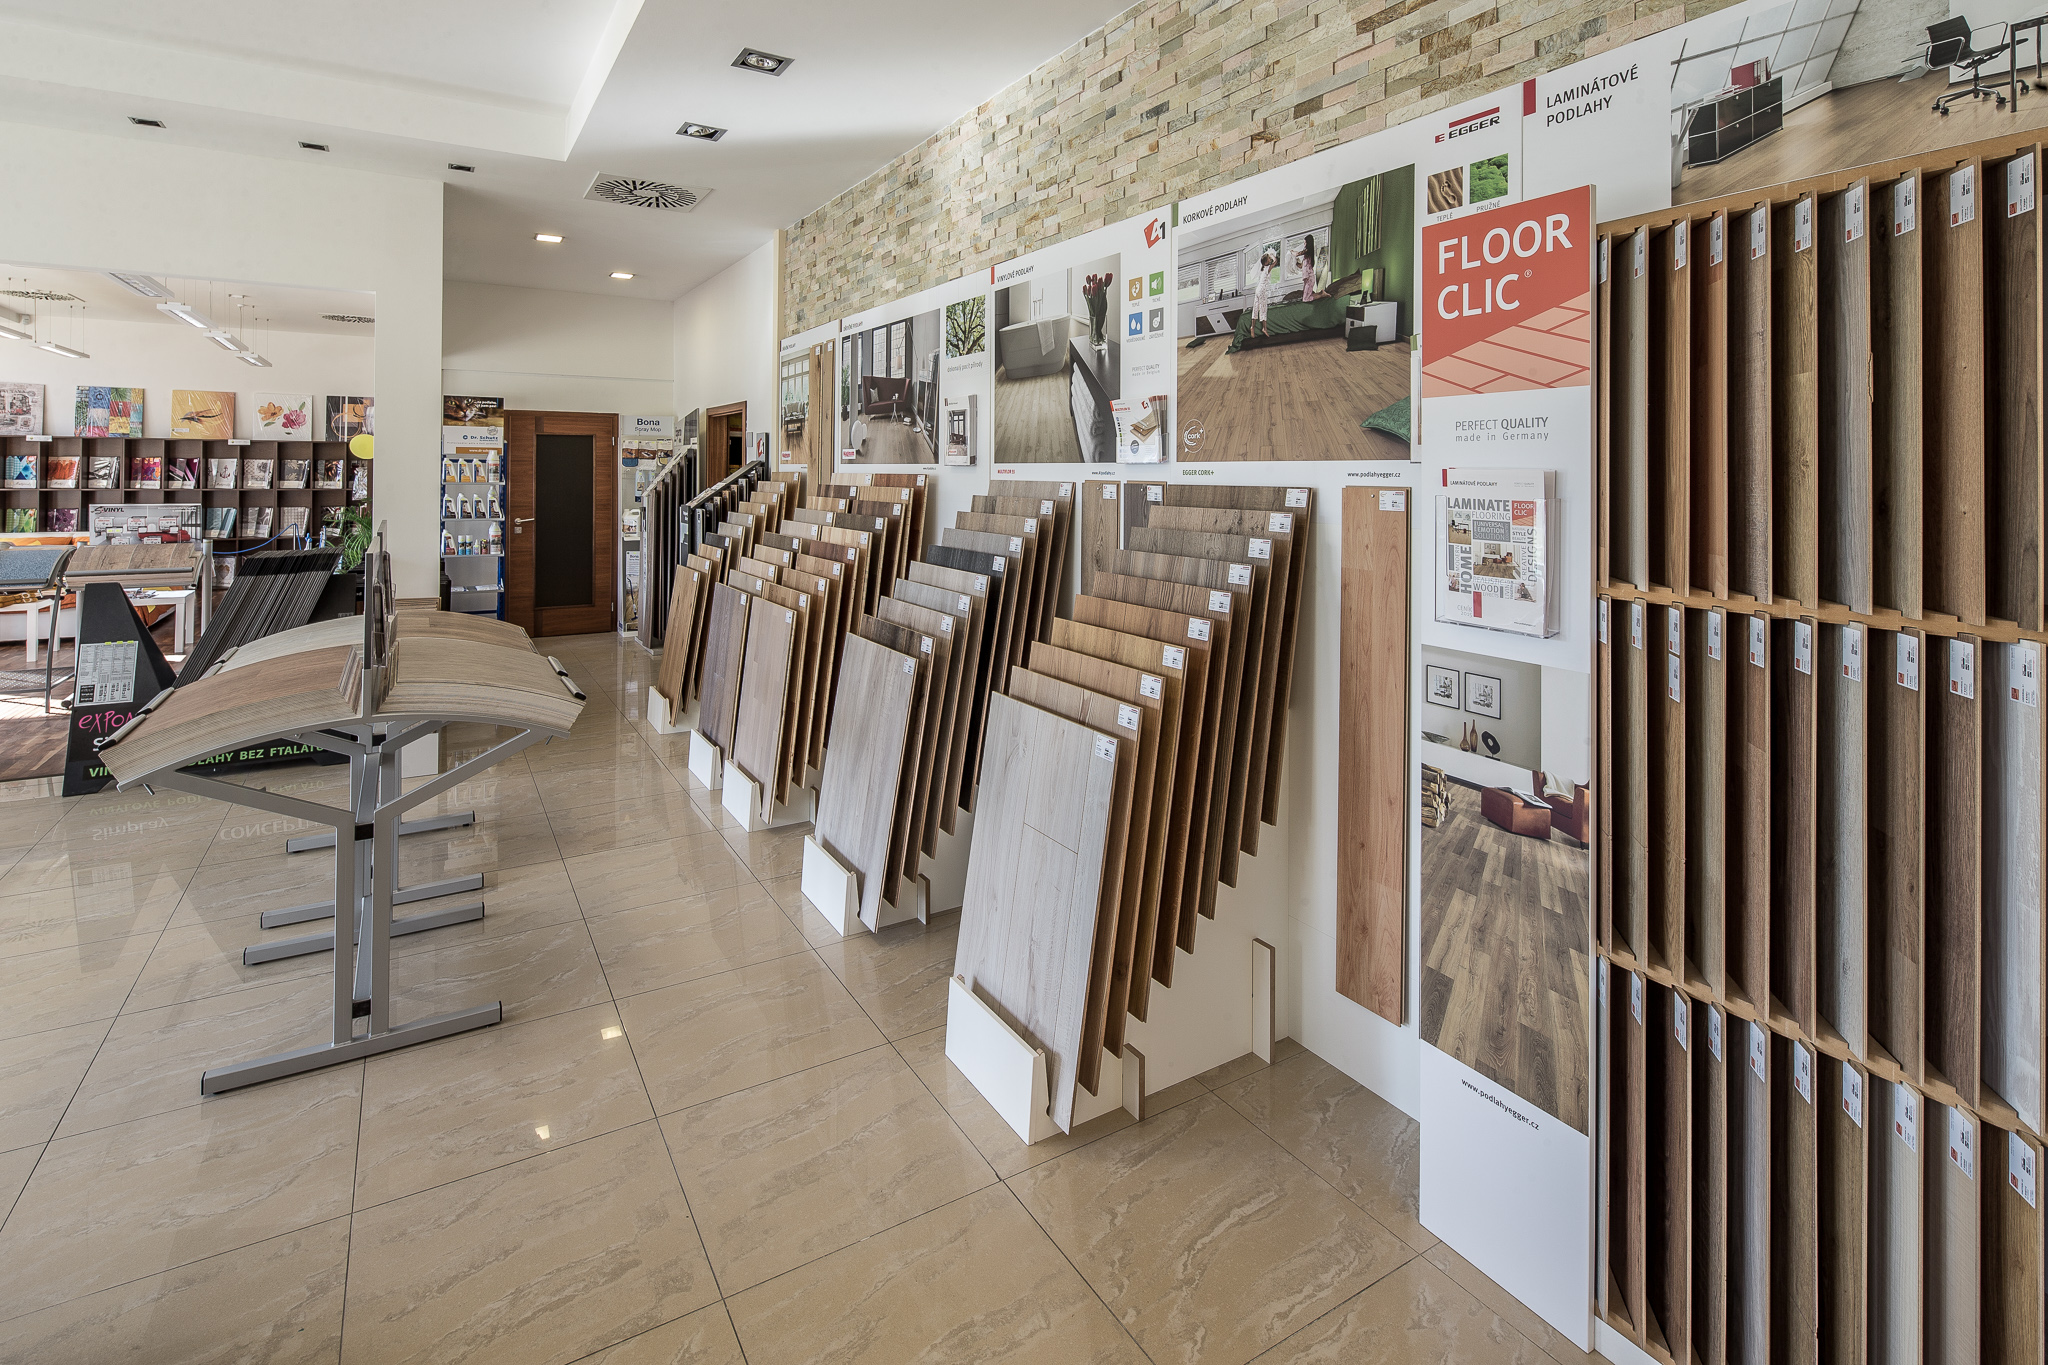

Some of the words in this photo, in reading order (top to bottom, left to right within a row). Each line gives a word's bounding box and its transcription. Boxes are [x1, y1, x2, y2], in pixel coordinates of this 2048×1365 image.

[1546, 63, 1639, 109] LAMINÁTOVÉ
[1546, 94, 1613, 128] PODLAHY
[1448, 115, 1501, 140] EGGER
[1182, 205, 1214, 225] KORKOVÉ
[1214, 195, 1248, 215] PODLAHY
[1476, 200, 1501, 213] PRUŽNÉ
[1436, 211, 1454, 222] TEPLÉ
[1438, 213, 1574, 275] FLOOR
[996, 269, 1015, 283] VINYLOVÉ
[1015, 264, 1035, 278] PODLAHY
[1437, 273, 1521, 320] CLIC
[1146, 363, 1160, 371] QUALITY
[636, 418, 660, 426] Bona
[1455, 418, 1498, 431] PERFECT
[1500, 416, 1549, 431] QUALITY
[1455, 432, 1481, 442] made
[1487, 432, 1496, 441] in
[1502, 431, 1549, 442] Germany
[1346, 471, 1401, 479] www.podlahyegger.cz
[1447, 497, 1511, 512] LAMINATE
[1471, 511, 1511, 521] FLOORING
[1526, 528, 1538, 583] DESIGNS
[1460, 546, 1473, 595] HOME
[1472, 583, 1499, 593] WOOD
[239, 748, 265, 761] BEZ
[1461, 1078, 1540, 1131] www.podlahyegger.cz
